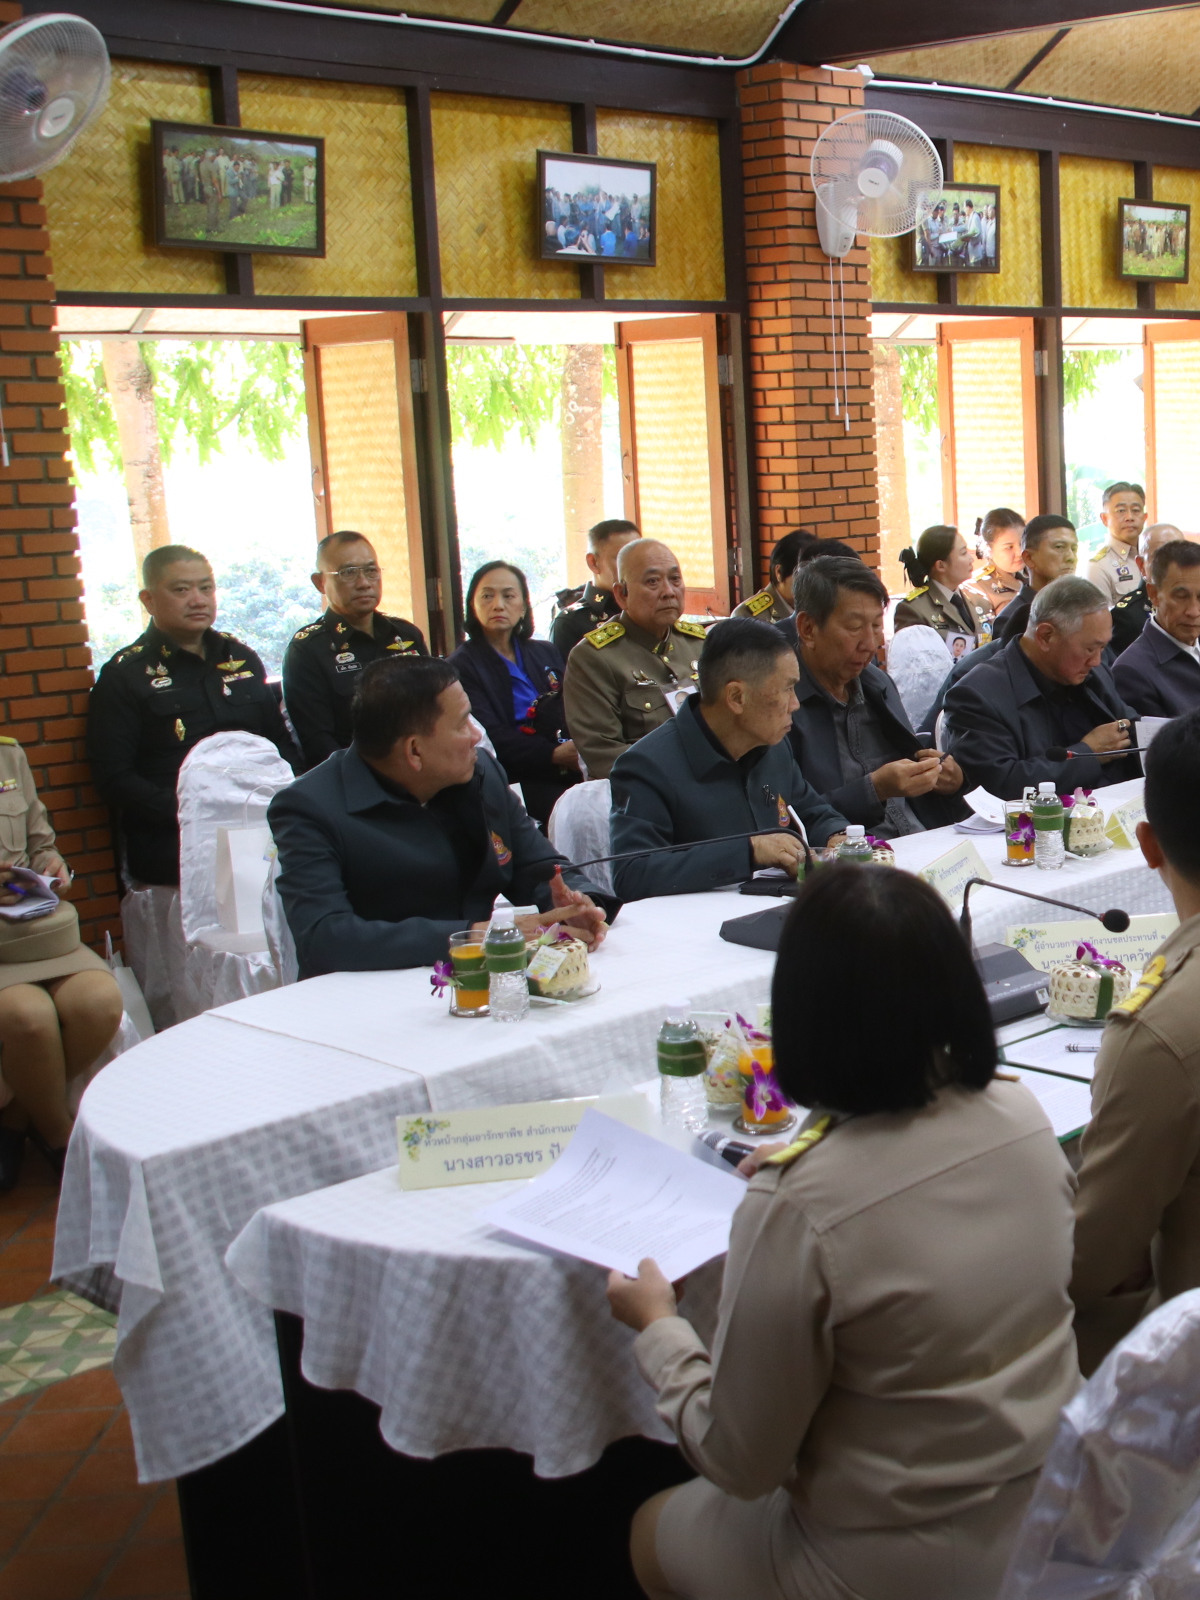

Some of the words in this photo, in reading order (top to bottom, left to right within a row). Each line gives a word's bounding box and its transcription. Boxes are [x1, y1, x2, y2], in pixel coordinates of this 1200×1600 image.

[1114, 947, 1153, 963] นาควัช
[424, 1127, 523, 1147] หัวหน้ากลุ่มอารักขาพืช
[526, 1123, 579, 1138] สำนักงานเก
[444, 1149, 544, 1173] นางสาวอรชร
